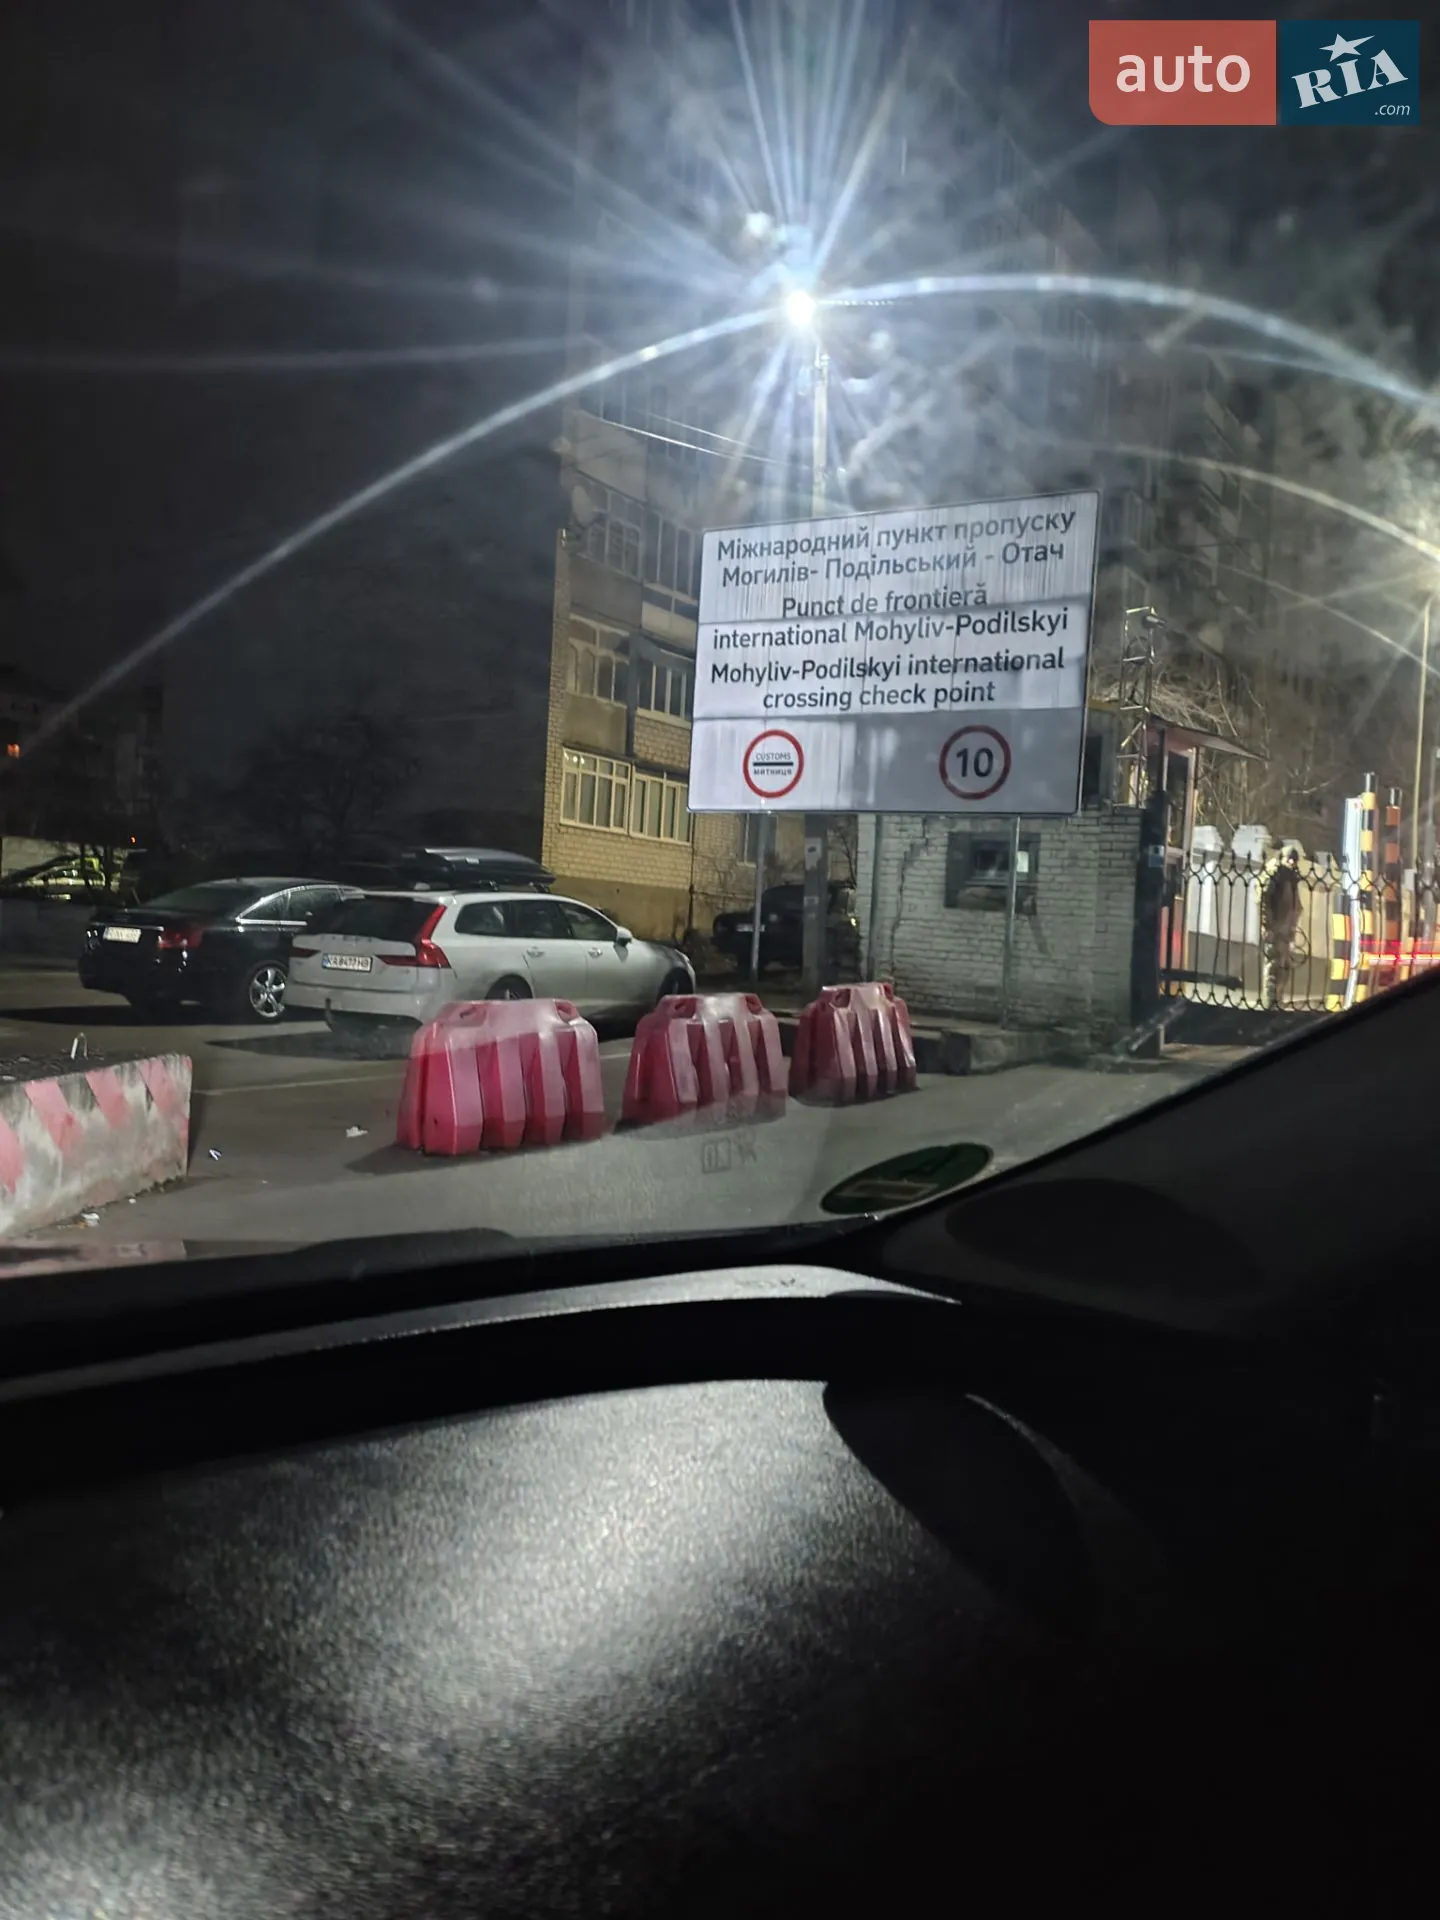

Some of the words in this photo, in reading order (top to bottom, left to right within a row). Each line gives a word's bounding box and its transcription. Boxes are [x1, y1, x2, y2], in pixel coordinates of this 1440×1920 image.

[717, 526, 870, 561] Міжнародний
[877, 524, 947, 551] пункт
[954, 511, 1076, 543] пропуску
[826, 545, 976, 582] Подільський
[1002, 542, 1064, 565] Отач
[782, 593, 845, 618] Punct
[851, 592, 878, 614] de
[885, 582, 988, 613] frontieră
[713, 622, 847, 650] international
[854, 607, 1068, 645] Mohyliv-Podilskyi
[711, 655, 901, 687] Mohyliv-Podilskyi
[908, 646, 1065, 676] international
[763, 686, 852, 711] crossing
[859, 683, 926, 705] check
[934, 680, 996, 708] point
[755, 752, 792, 761] CUSTOMS
[955, 746, 995, 778] 10
